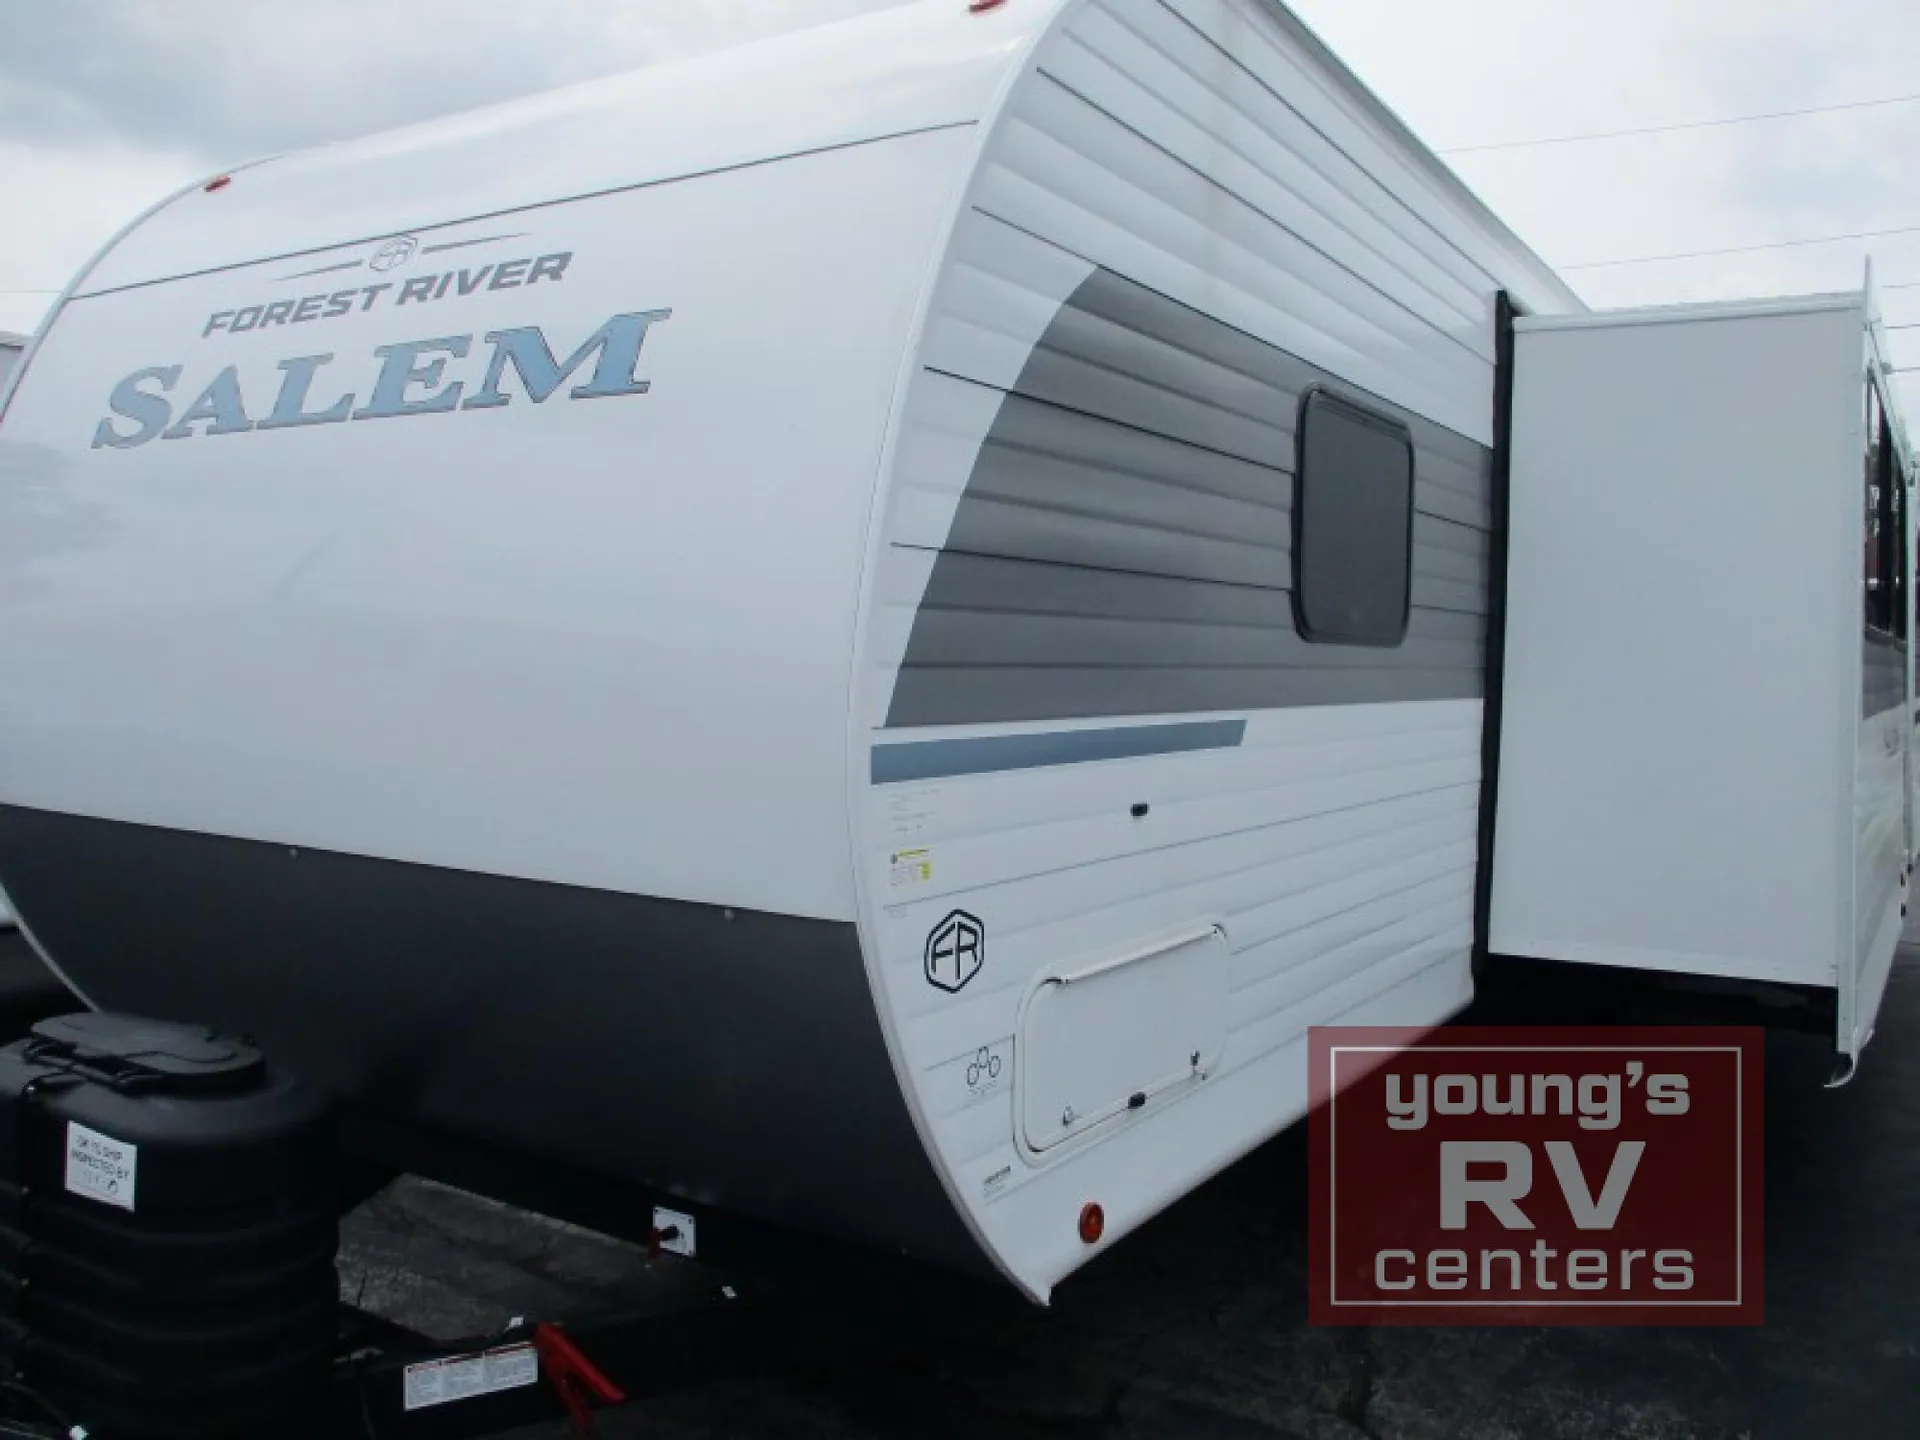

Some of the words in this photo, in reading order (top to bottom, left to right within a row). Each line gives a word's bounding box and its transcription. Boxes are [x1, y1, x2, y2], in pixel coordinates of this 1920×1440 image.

[202, 283, 393, 338] FOREST
[397, 251, 573, 305] RIVER
[91, 307, 672, 449] SALEM
[929, 918, 981, 983] FR
